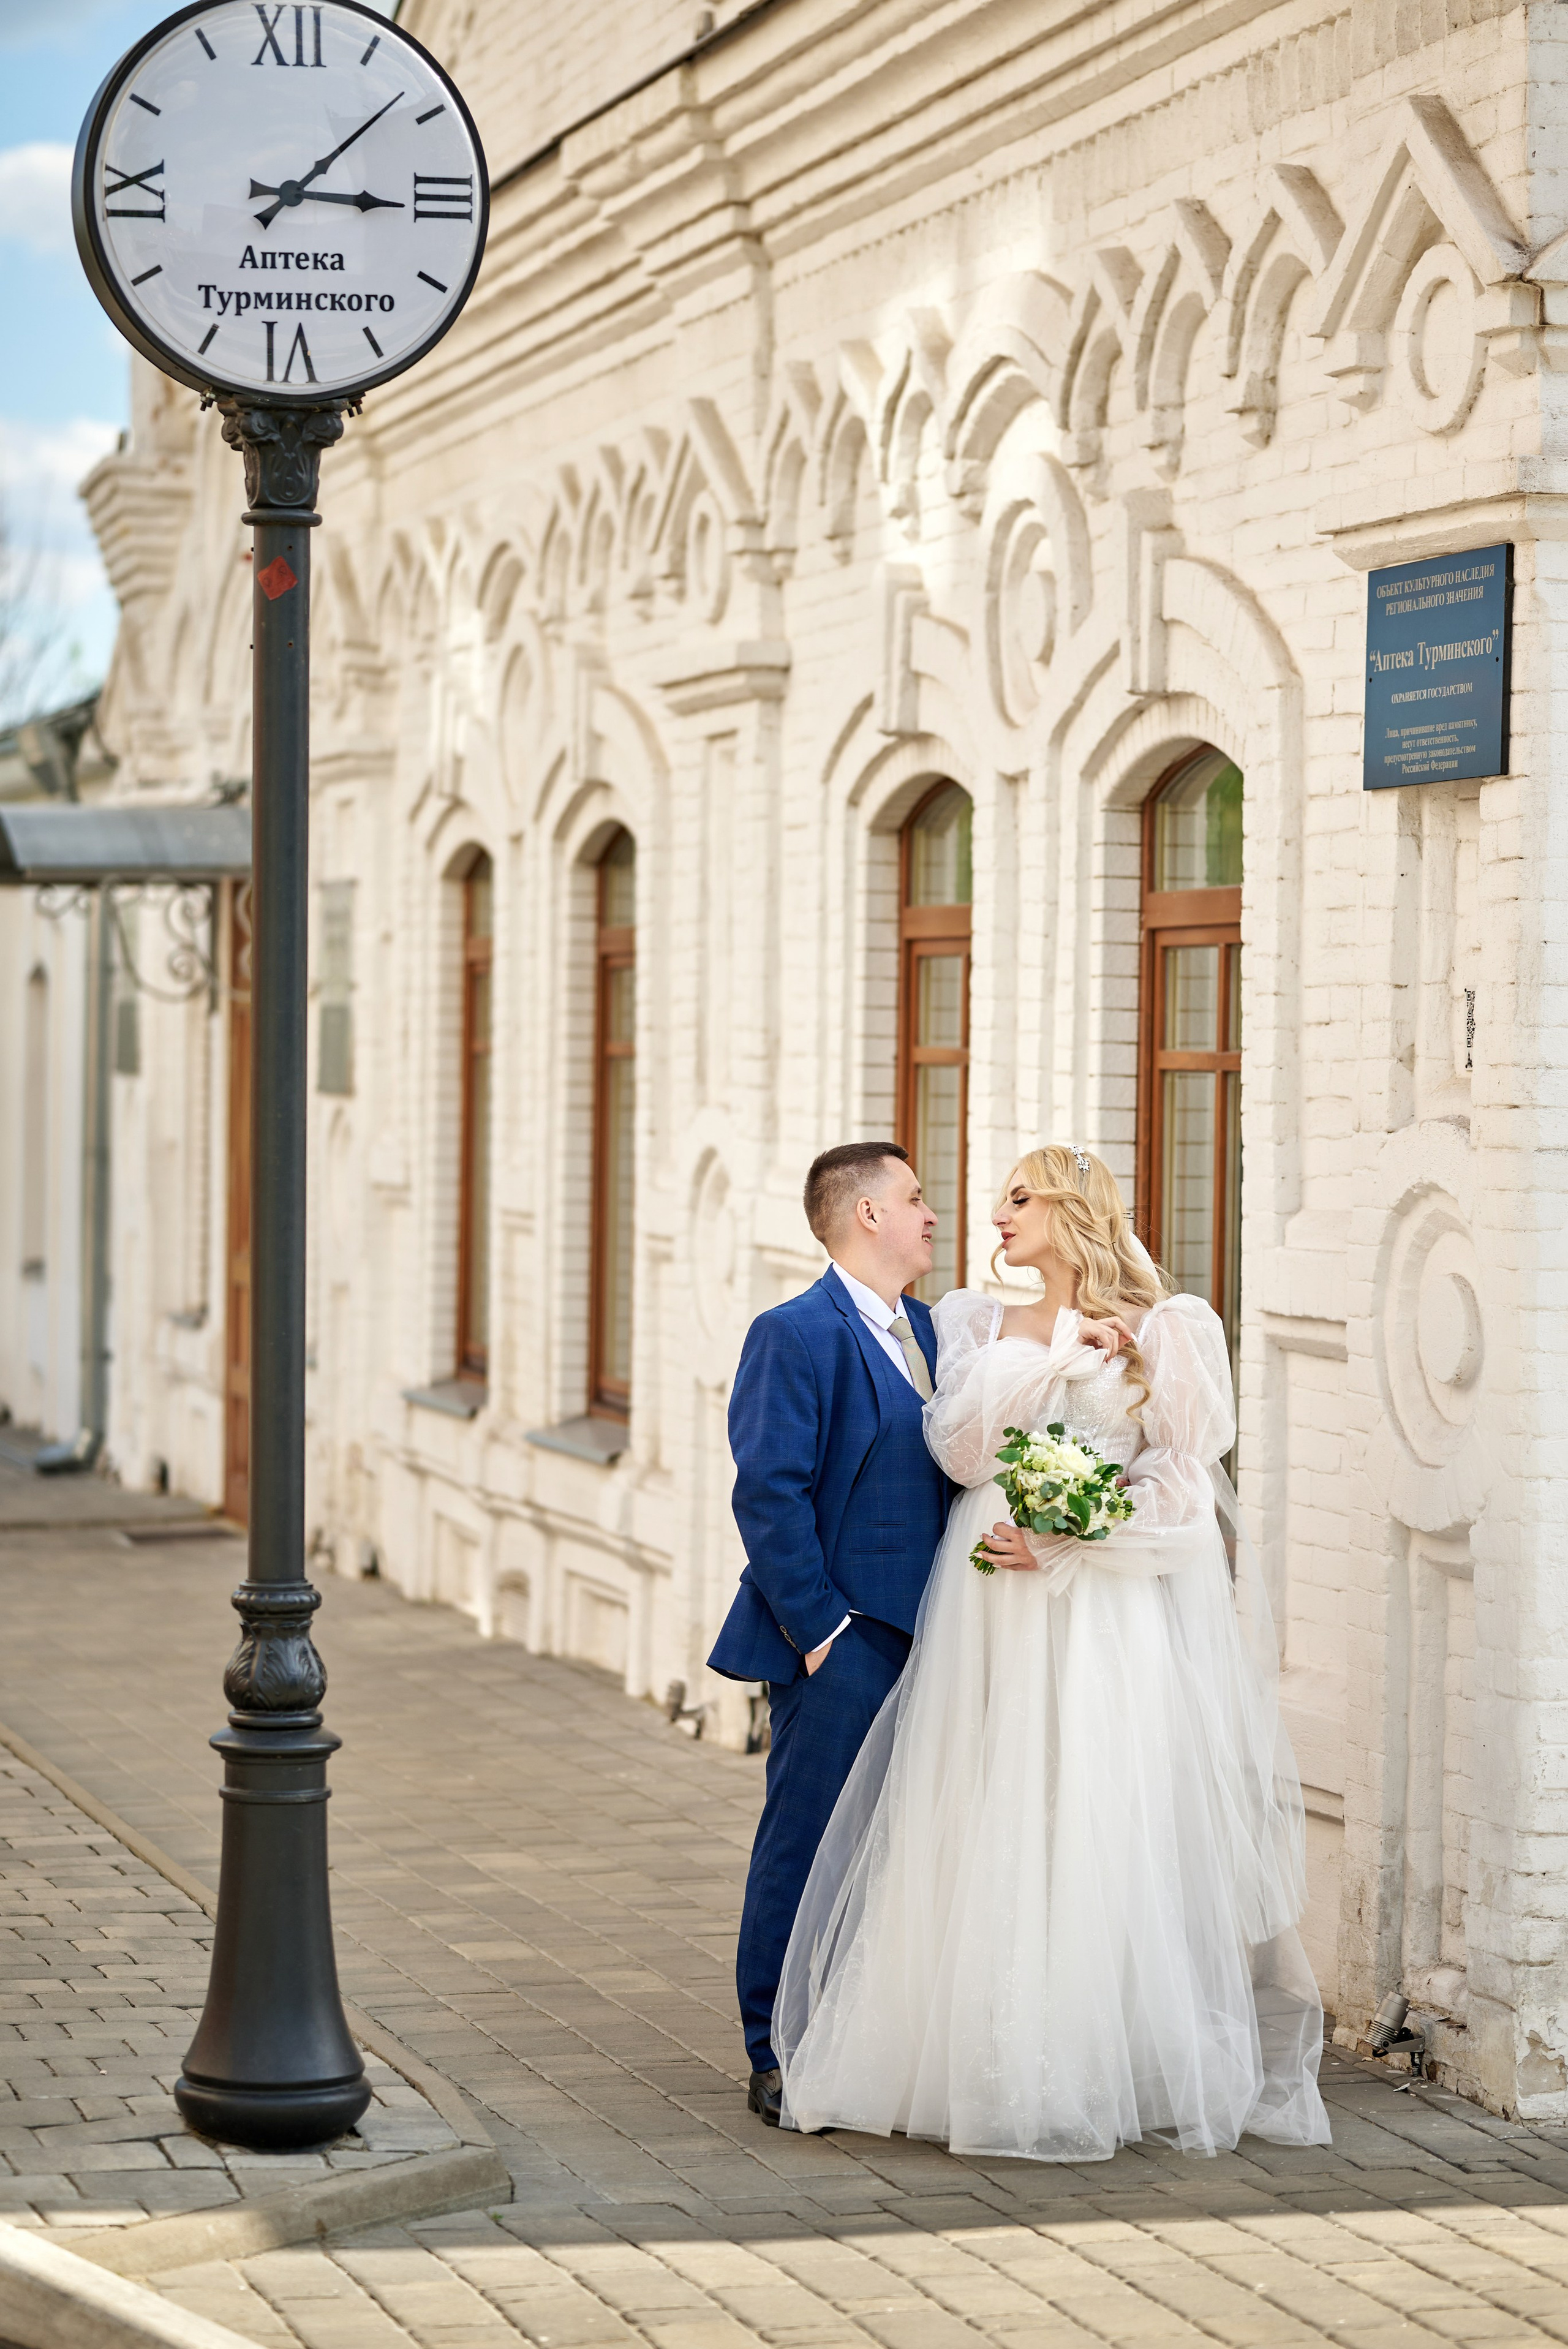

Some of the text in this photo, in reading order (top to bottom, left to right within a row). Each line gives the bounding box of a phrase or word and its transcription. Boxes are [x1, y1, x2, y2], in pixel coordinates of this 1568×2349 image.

[251, 4, 327, 67] XII
[413, 172, 473, 223] III
[238, 245, 345, 271] Аптека
[198, 284, 395, 315] Турминского
[1376, 564, 1495, 598] ОБЪЕКТ КУЛЬТУРНОГО НАСЛЕДИЯ
[1385, 586, 1484, 616] РЕГИОНАЛЬНОГО ЗНАЧЕНИЯ
[1391, 682, 1473, 704] ОХРАНЯЕТСЯ ГОСУДАРСТВОМ
